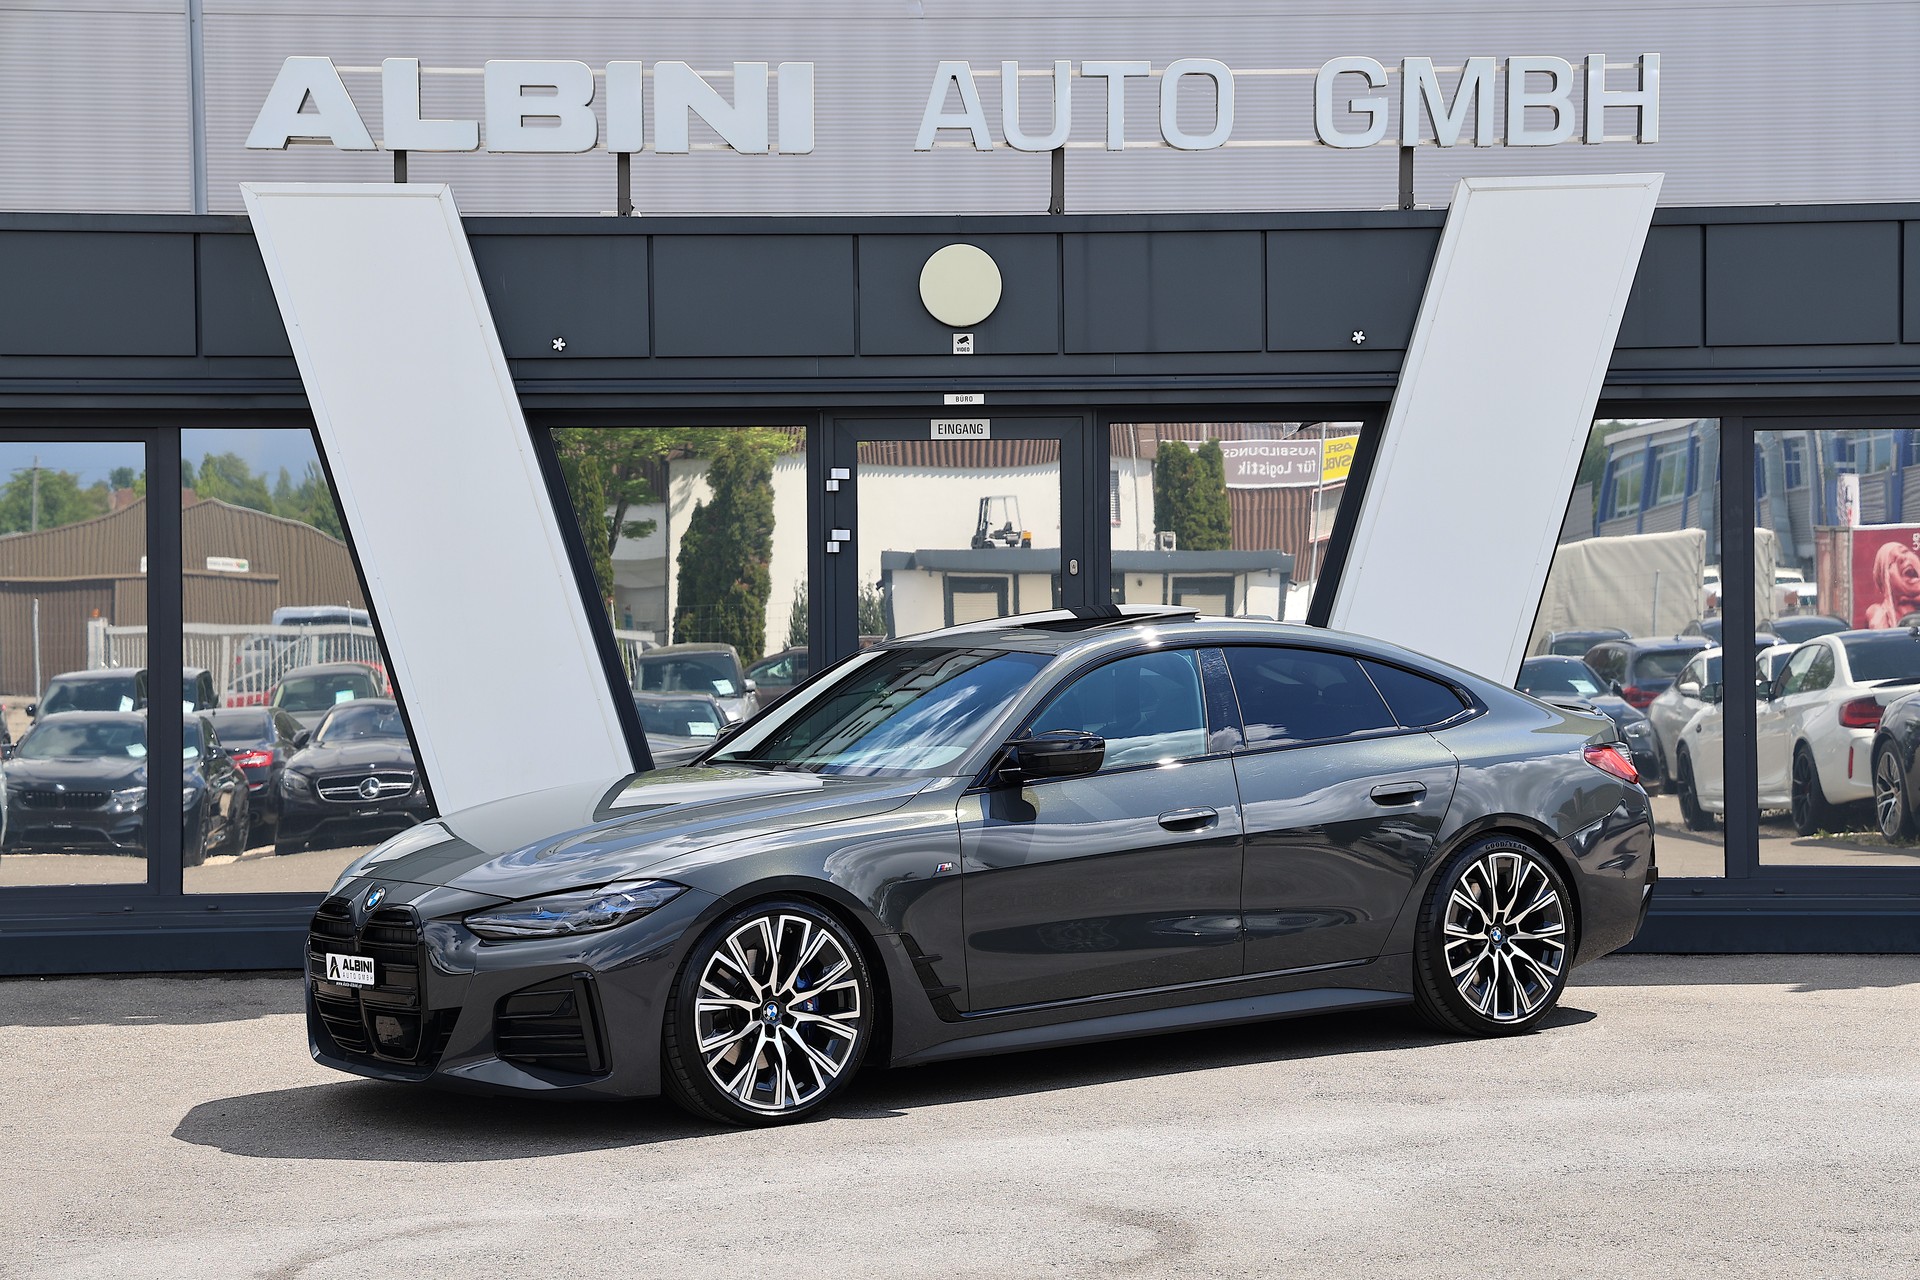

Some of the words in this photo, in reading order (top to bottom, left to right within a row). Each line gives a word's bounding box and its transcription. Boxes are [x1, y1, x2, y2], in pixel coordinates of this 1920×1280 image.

[245, 56, 815, 155] ALBINI
[913, 57, 1235, 152] AUTO
[1313, 52, 1662, 149] GMBH
[955, 395, 974, 403] BÜRO
[937, 423, 984, 435] EINGANG
[342, 958, 373, 973] ALBINI
[342, 971, 356, 979] AUTO
